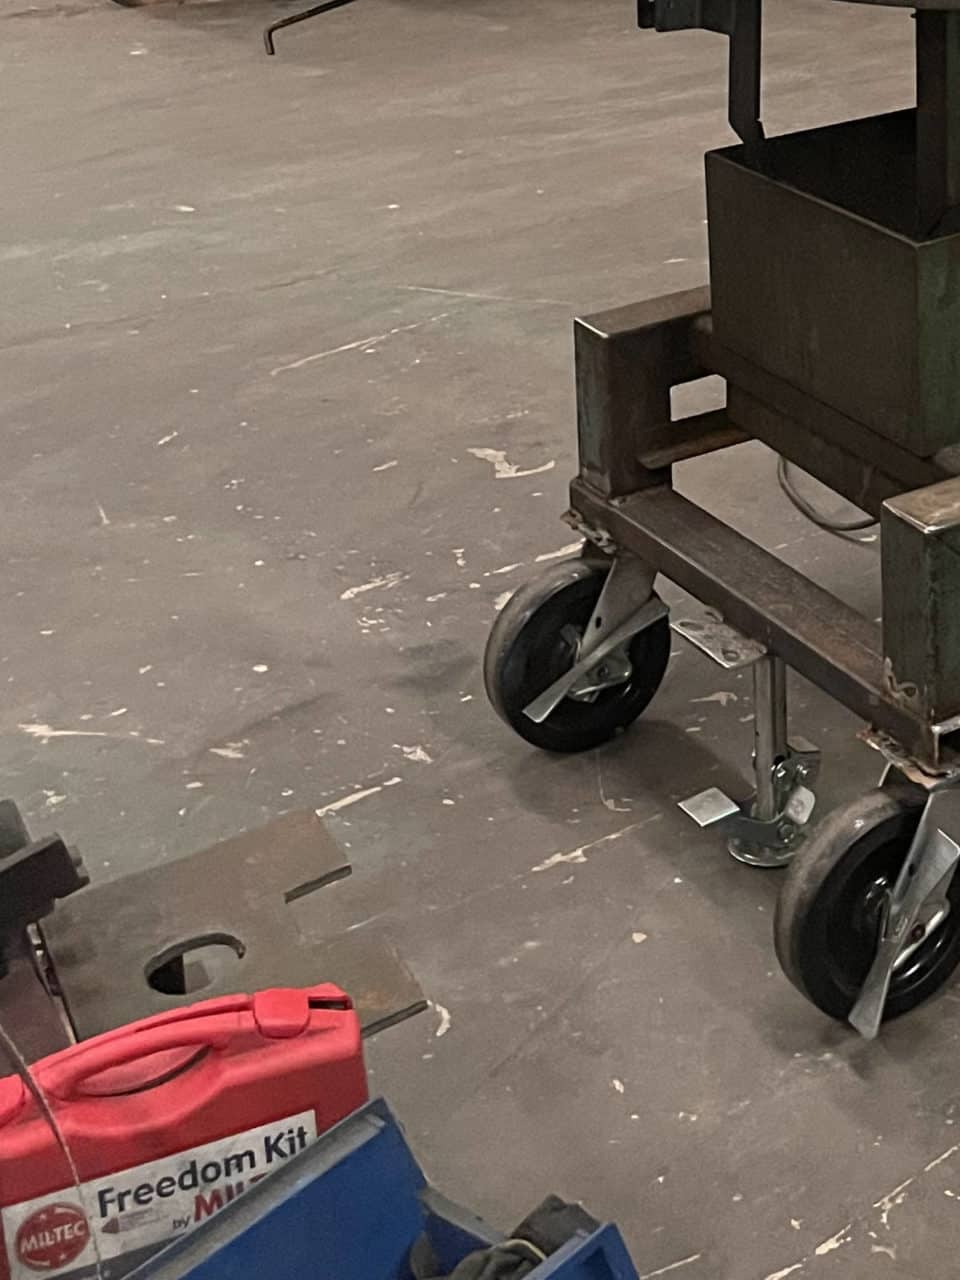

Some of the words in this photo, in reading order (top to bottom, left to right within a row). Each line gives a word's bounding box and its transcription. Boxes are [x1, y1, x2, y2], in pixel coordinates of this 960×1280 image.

[97, 1148, 256, 1218] Freedom
[263, 1125, 308, 1163] Kit
[172, 1215, 191, 1231] by
